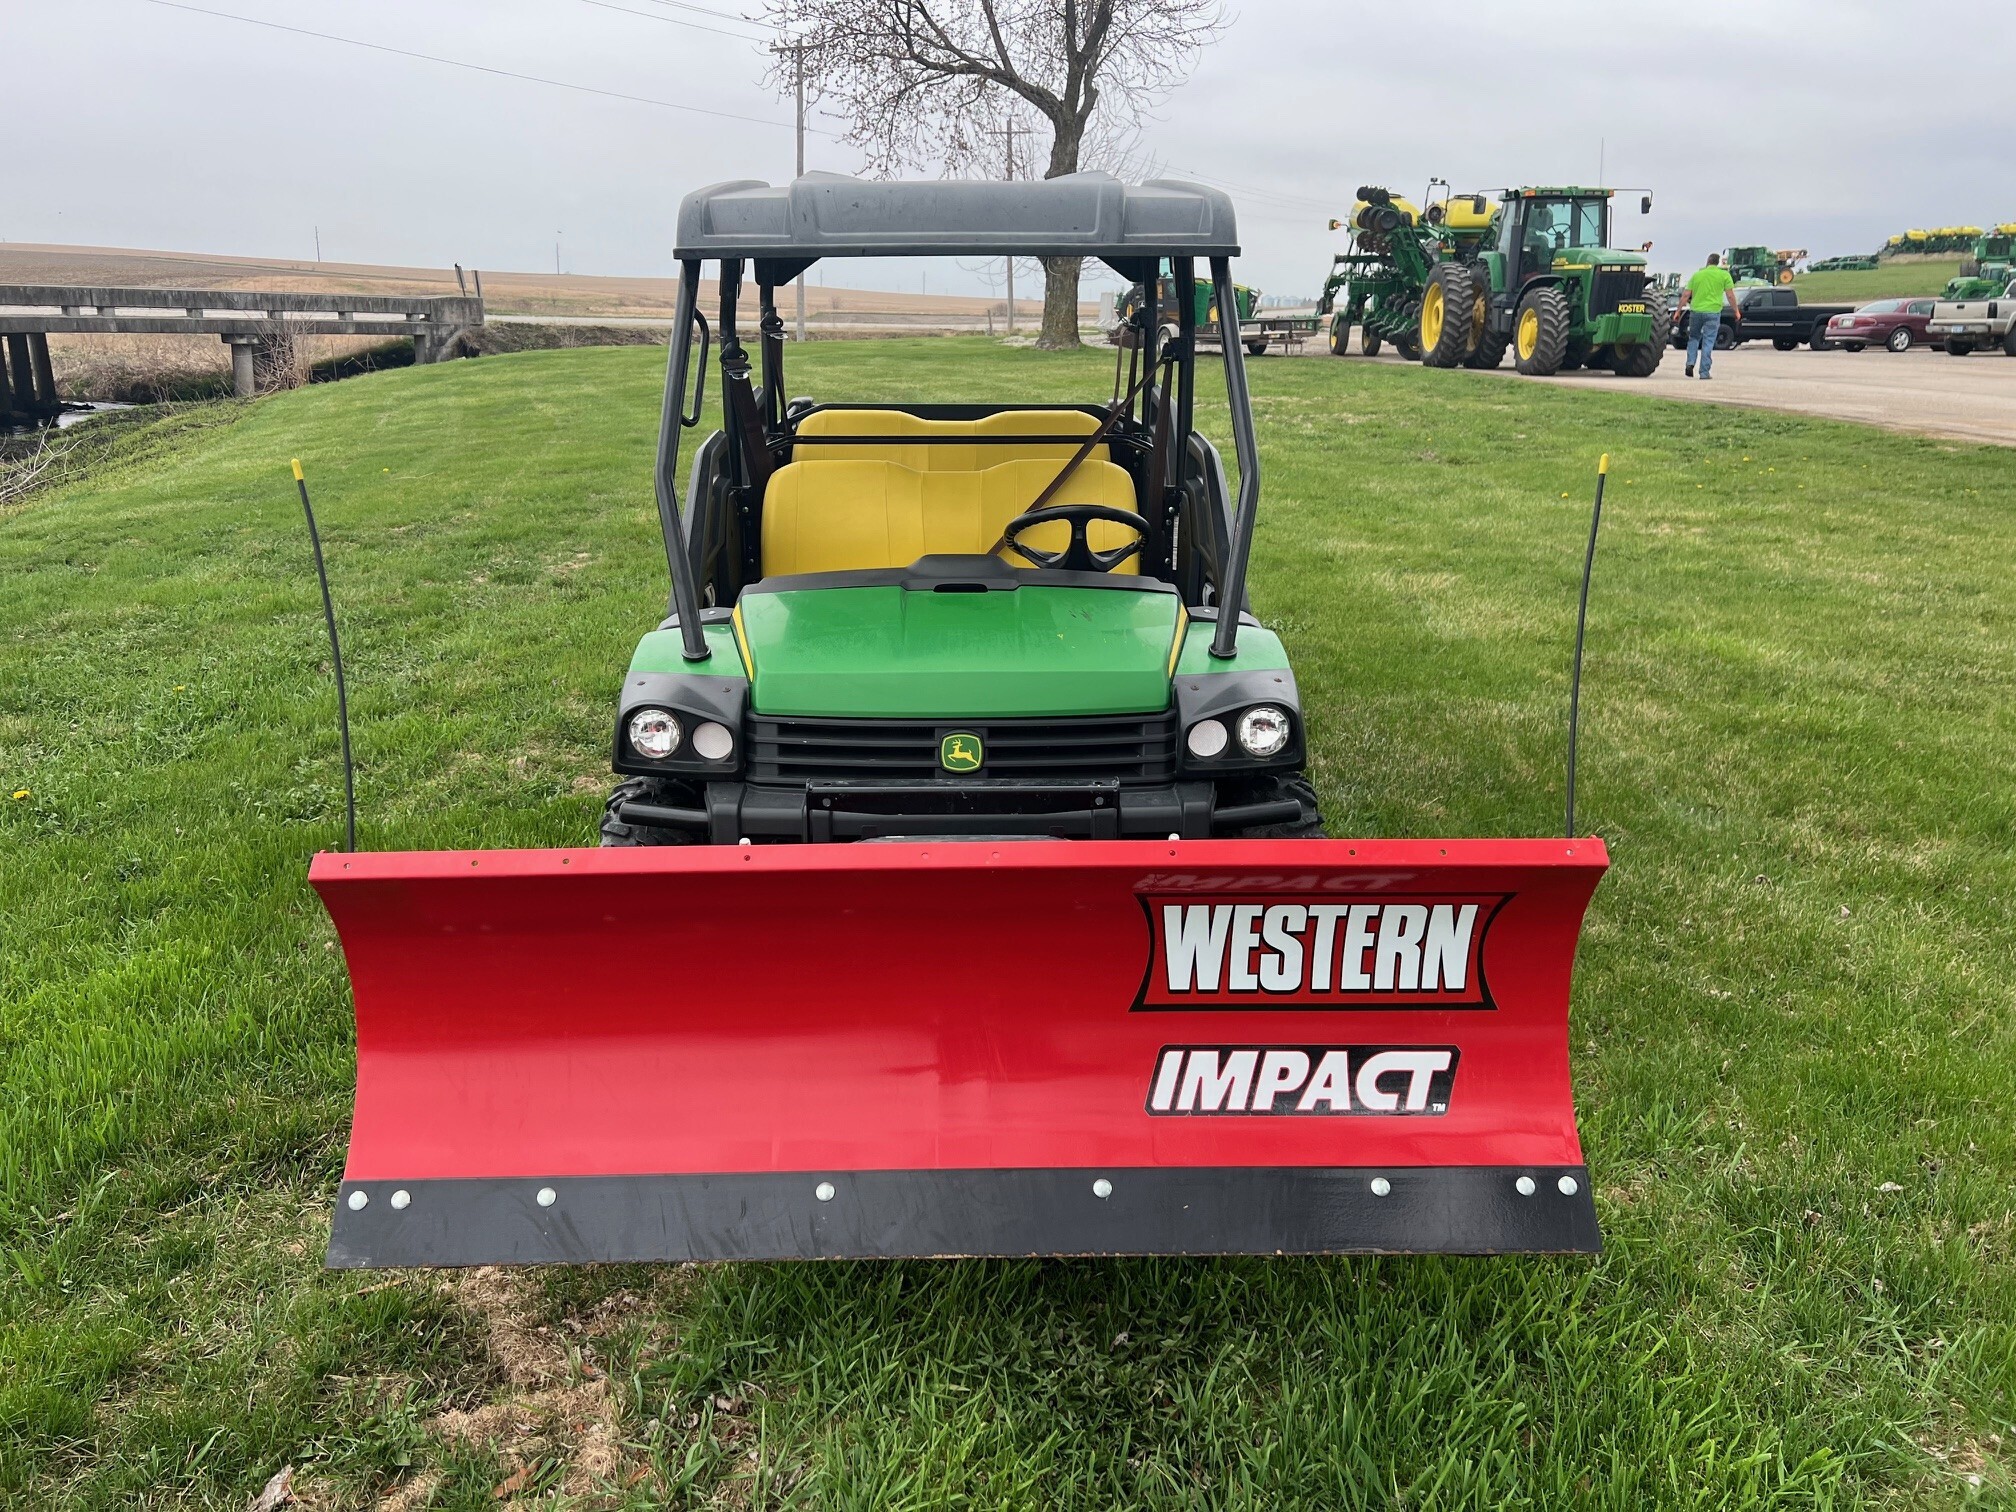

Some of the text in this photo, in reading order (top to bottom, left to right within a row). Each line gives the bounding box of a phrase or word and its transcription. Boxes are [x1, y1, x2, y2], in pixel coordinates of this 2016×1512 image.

[1618, 303, 1646, 313] KOSTER
[1162, 903, 1479, 992] WESTERN
[1151, 1050, 1452, 1111] IMPACT
